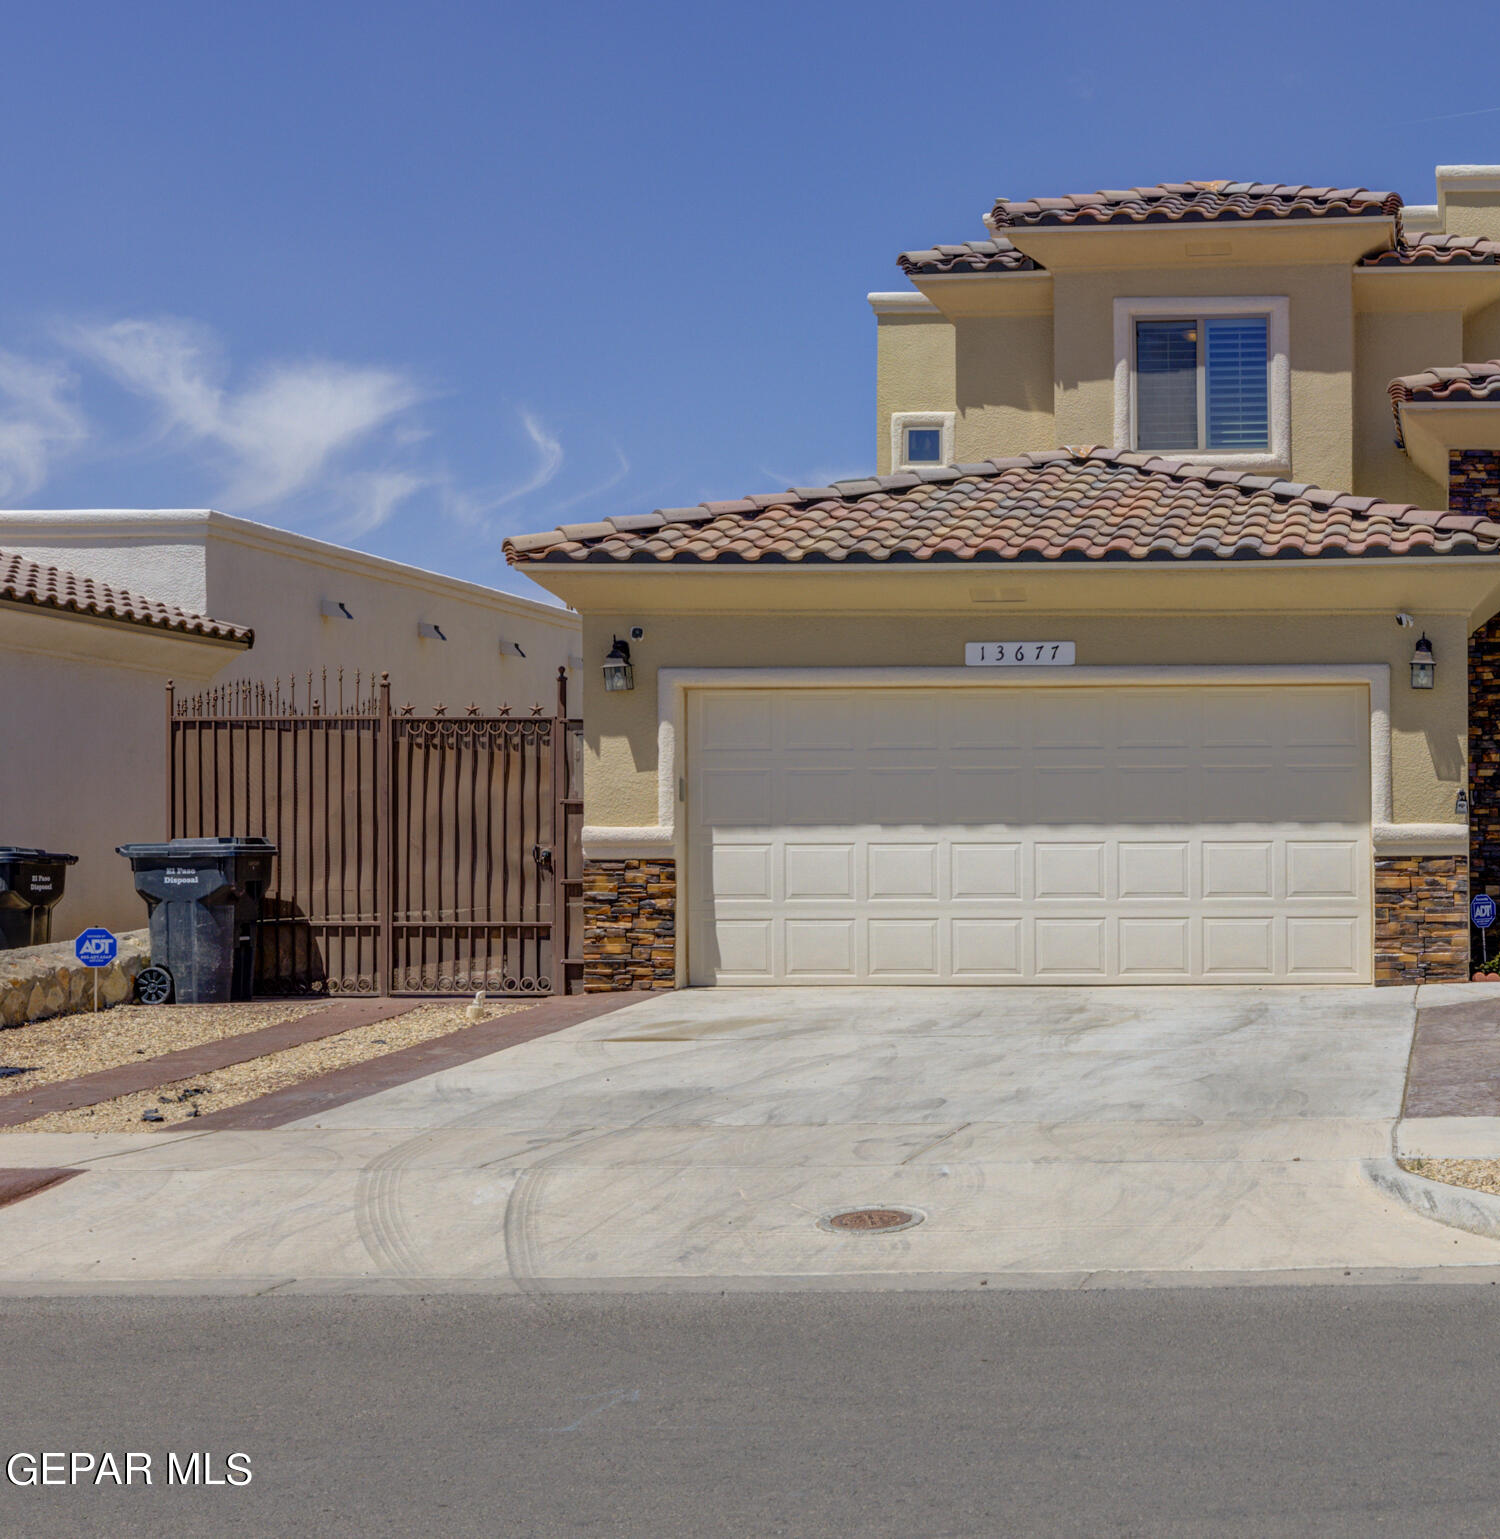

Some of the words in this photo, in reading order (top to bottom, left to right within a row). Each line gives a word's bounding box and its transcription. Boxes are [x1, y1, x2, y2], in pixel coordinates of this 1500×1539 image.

[980, 645, 1060, 662] 13677
[166, 867, 176, 875] El
[176, 867, 196, 875] Paso
[164, 876, 198, 885] Disposal
[1474, 905, 1491, 917] ADT
[80, 939, 114, 954] ADT
